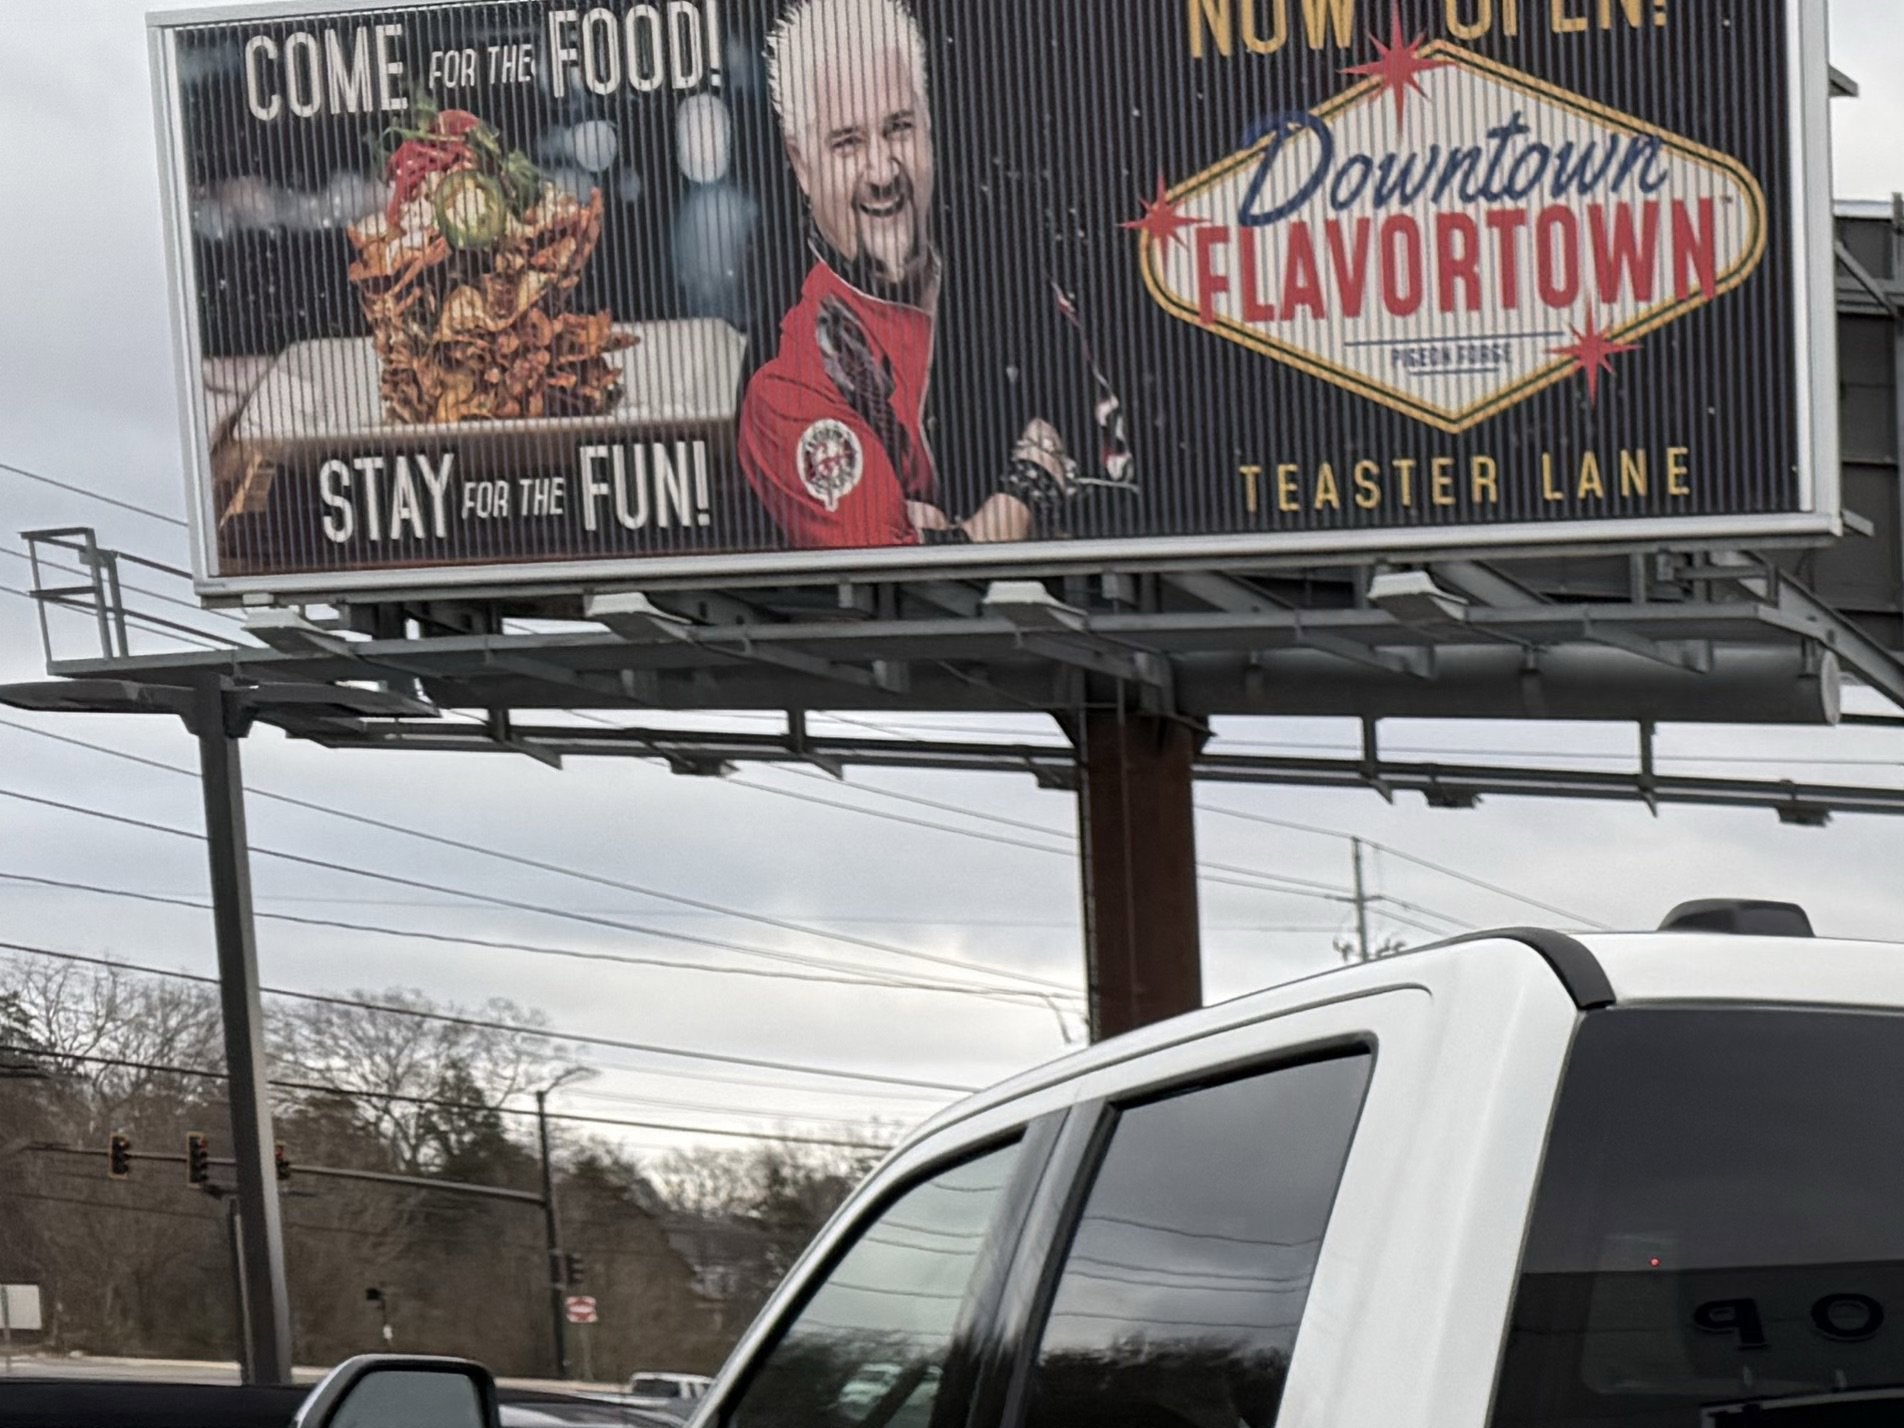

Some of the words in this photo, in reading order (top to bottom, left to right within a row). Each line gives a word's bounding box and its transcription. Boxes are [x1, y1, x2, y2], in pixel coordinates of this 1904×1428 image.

[245, 22, 408, 121] COME
[429, 47, 477, 89] FOR
[487, 42, 535, 85] THE
[547, 0, 722, 98] FOOD!
[1237, 110, 1669, 227] Downtown
[1195, 196, 1717, 325] FLAVORTOWN
[319, 452, 455, 544] STAY
[461, 480, 508, 519] FOR
[519, 476, 565, 516] THE
[579, 440, 711, 531] FUN!
[1239, 455, 1498, 512] TEASTER
[1541, 446, 1691, 500] LANE
